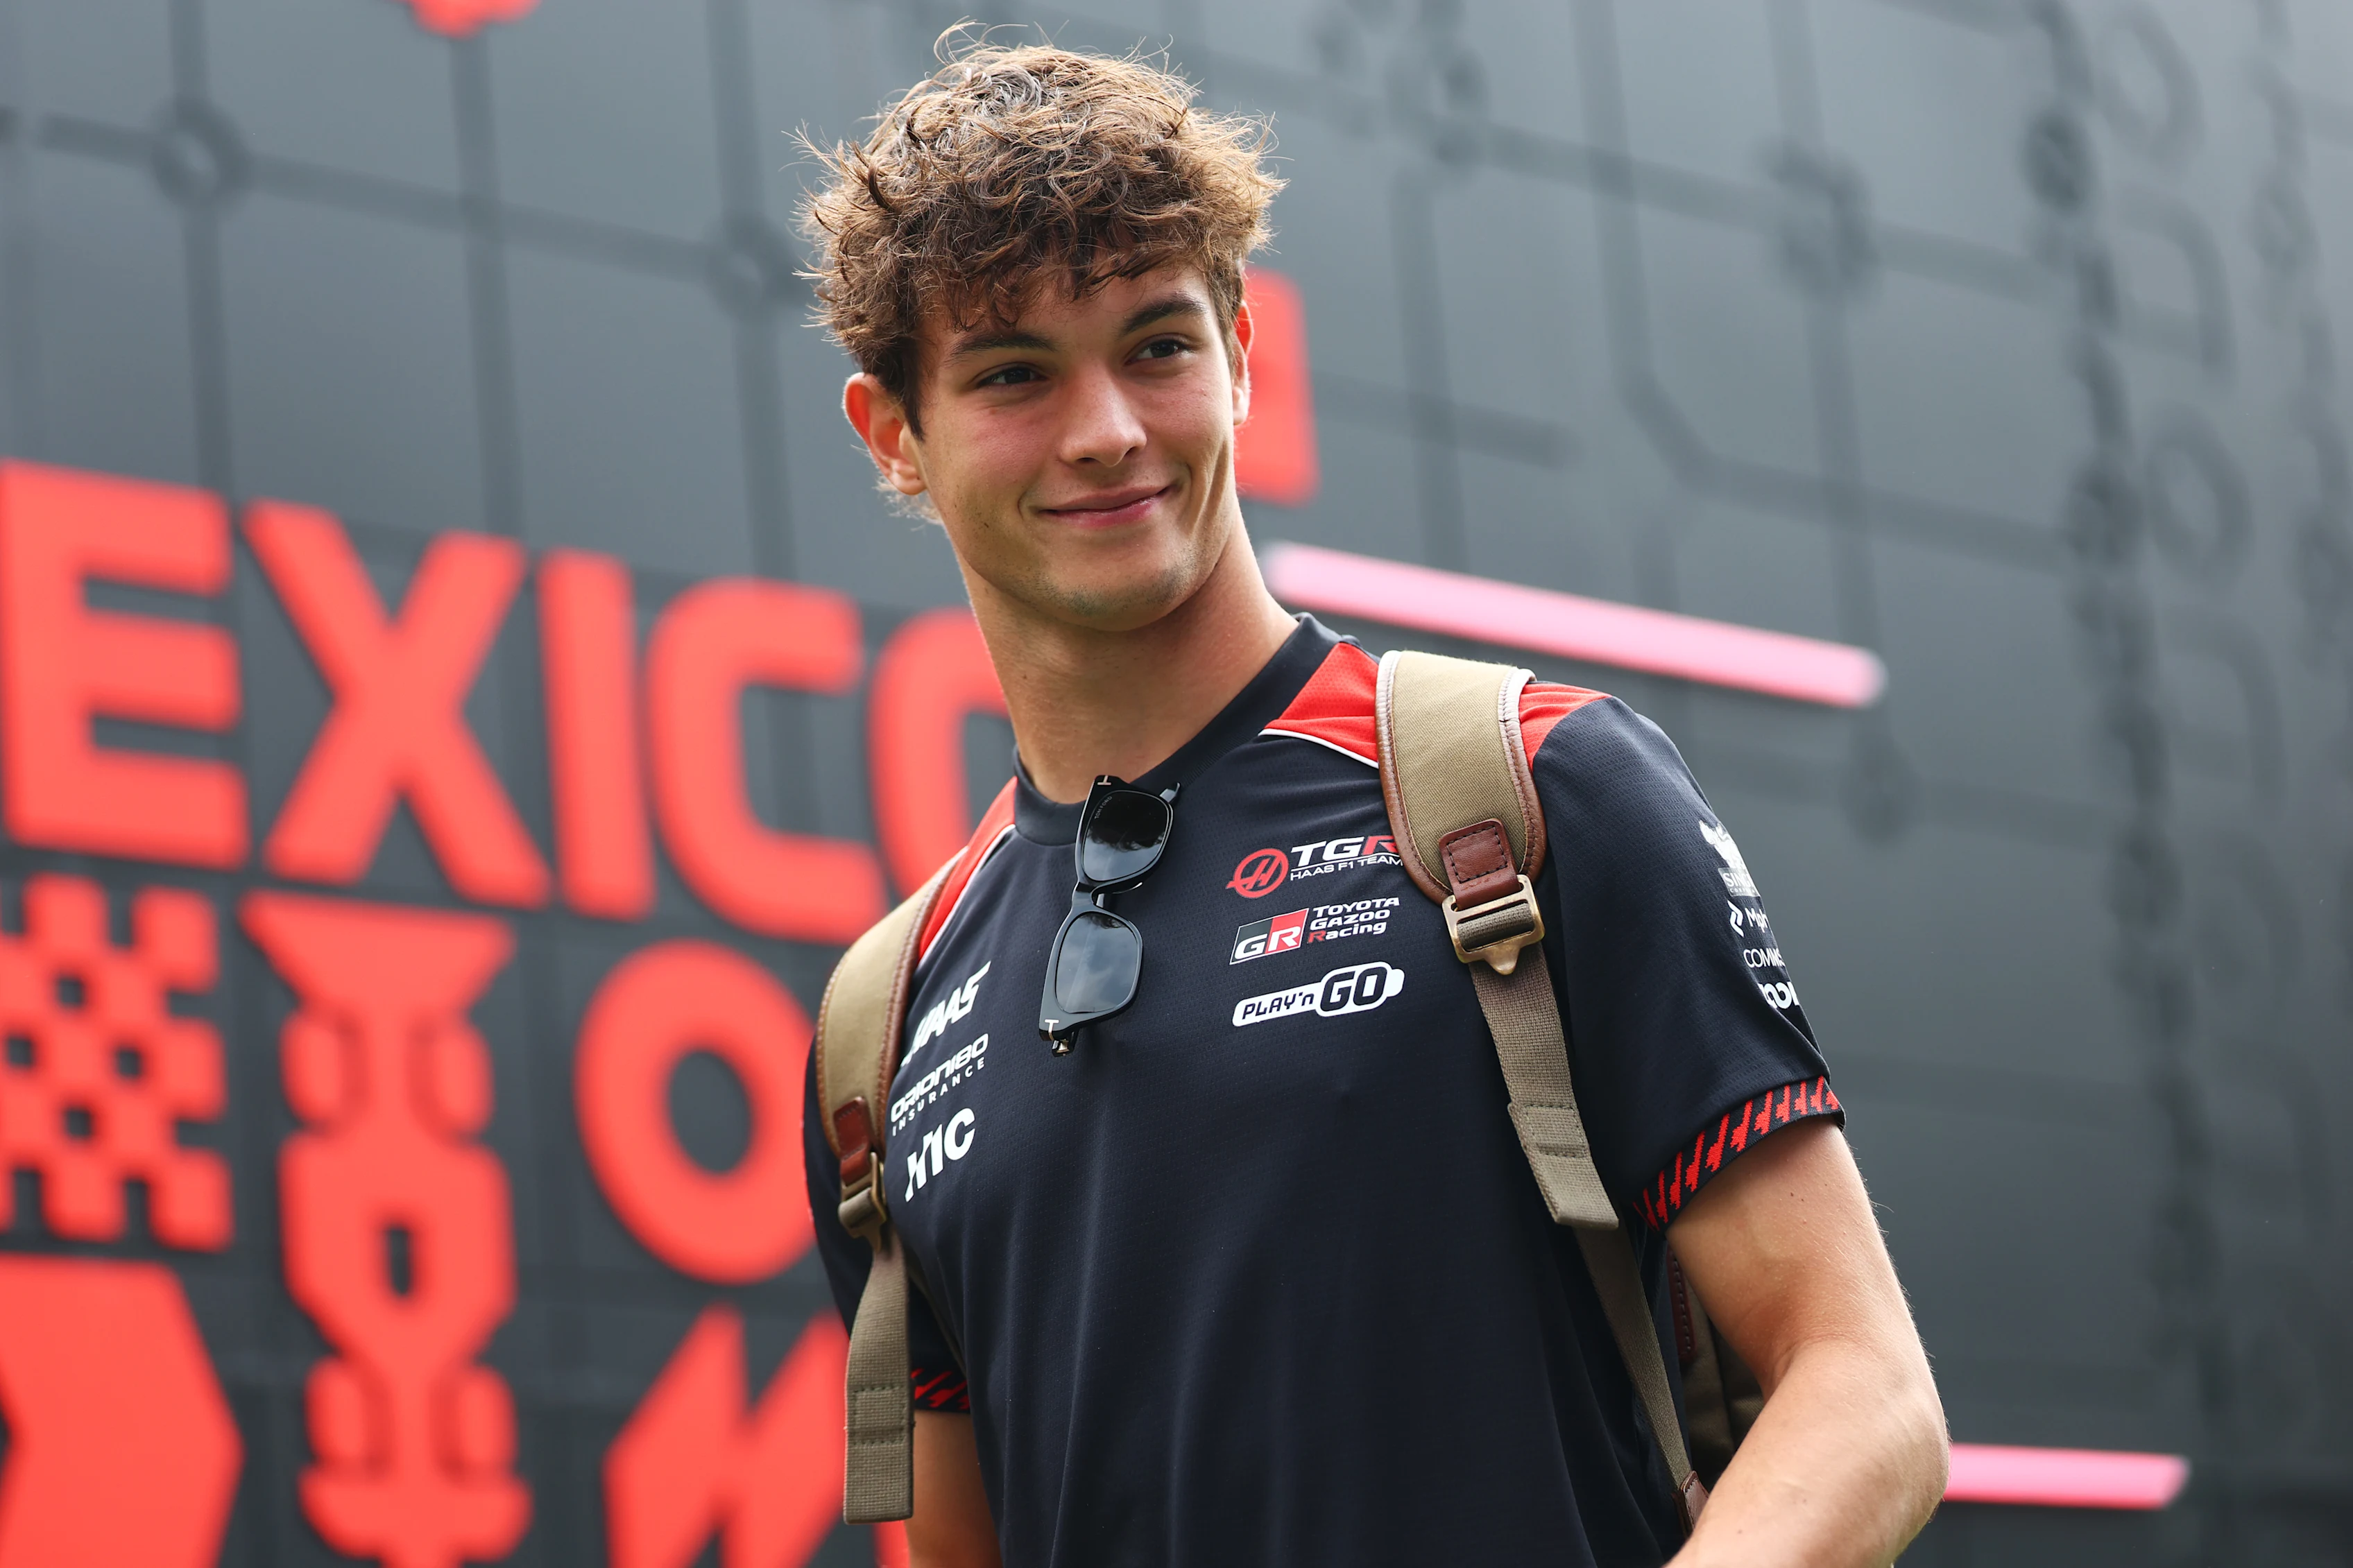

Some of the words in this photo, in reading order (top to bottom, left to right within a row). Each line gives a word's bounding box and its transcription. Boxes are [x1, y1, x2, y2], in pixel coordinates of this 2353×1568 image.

[1290, 834, 1398, 868] TGR
[1290, 863, 1335, 881] HAAS
[1338, 861, 1354, 872] F1
[1357, 854, 1403, 867] TEAM
[1310, 909, 1391, 931] GAZOO
[1312, 897, 1401, 918] TOYOTA
[1234, 926, 1301, 960] GR
[1308, 922, 1387, 943] Racing
[1242, 992, 1315, 1020] PLAY'n
[1320, 966, 1388, 1012] GO
[892, 1056, 985, 1137] INSURANCE
